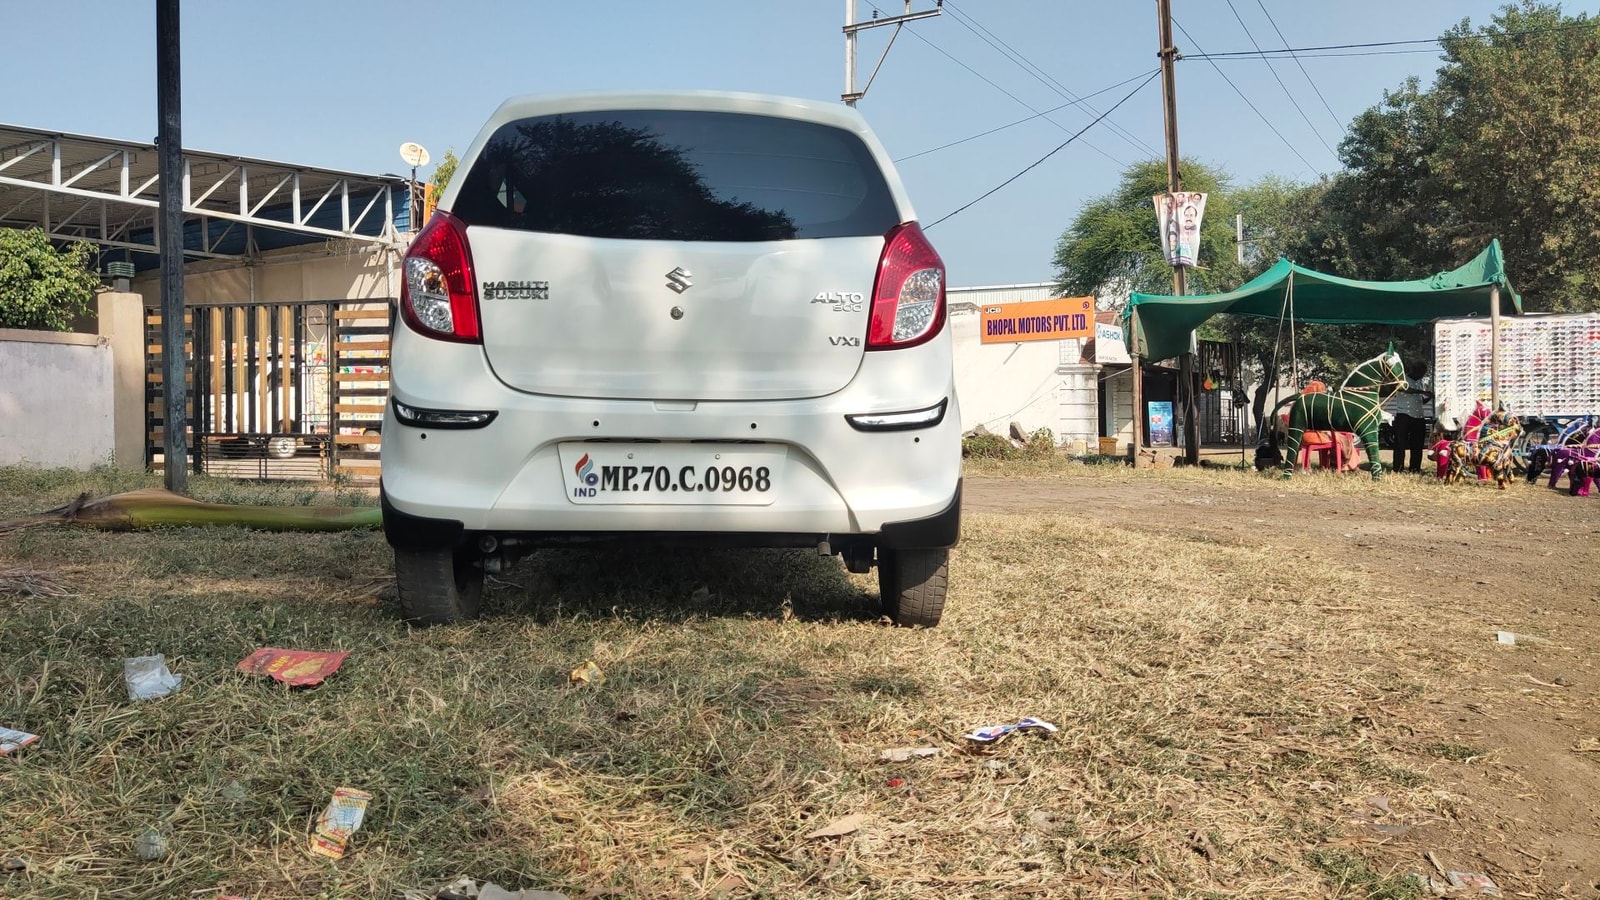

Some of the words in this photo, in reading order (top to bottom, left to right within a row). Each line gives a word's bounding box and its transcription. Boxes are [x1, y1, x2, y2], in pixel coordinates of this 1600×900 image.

[483, 281, 549, 290] MARUTI
[483, 289, 549, 300] SUZUKI
[811, 291, 864, 304] ALTO
[987, 317, 1017, 336] BHOPAL
[1018, 315, 1052, 334] MOTORS
[1053, 314, 1071, 332] PVT.
[1071, 313, 1088, 331] LTD.
[1102, 329, 1122, 341] ASHOK
[574, 487, 597, 497] IND
